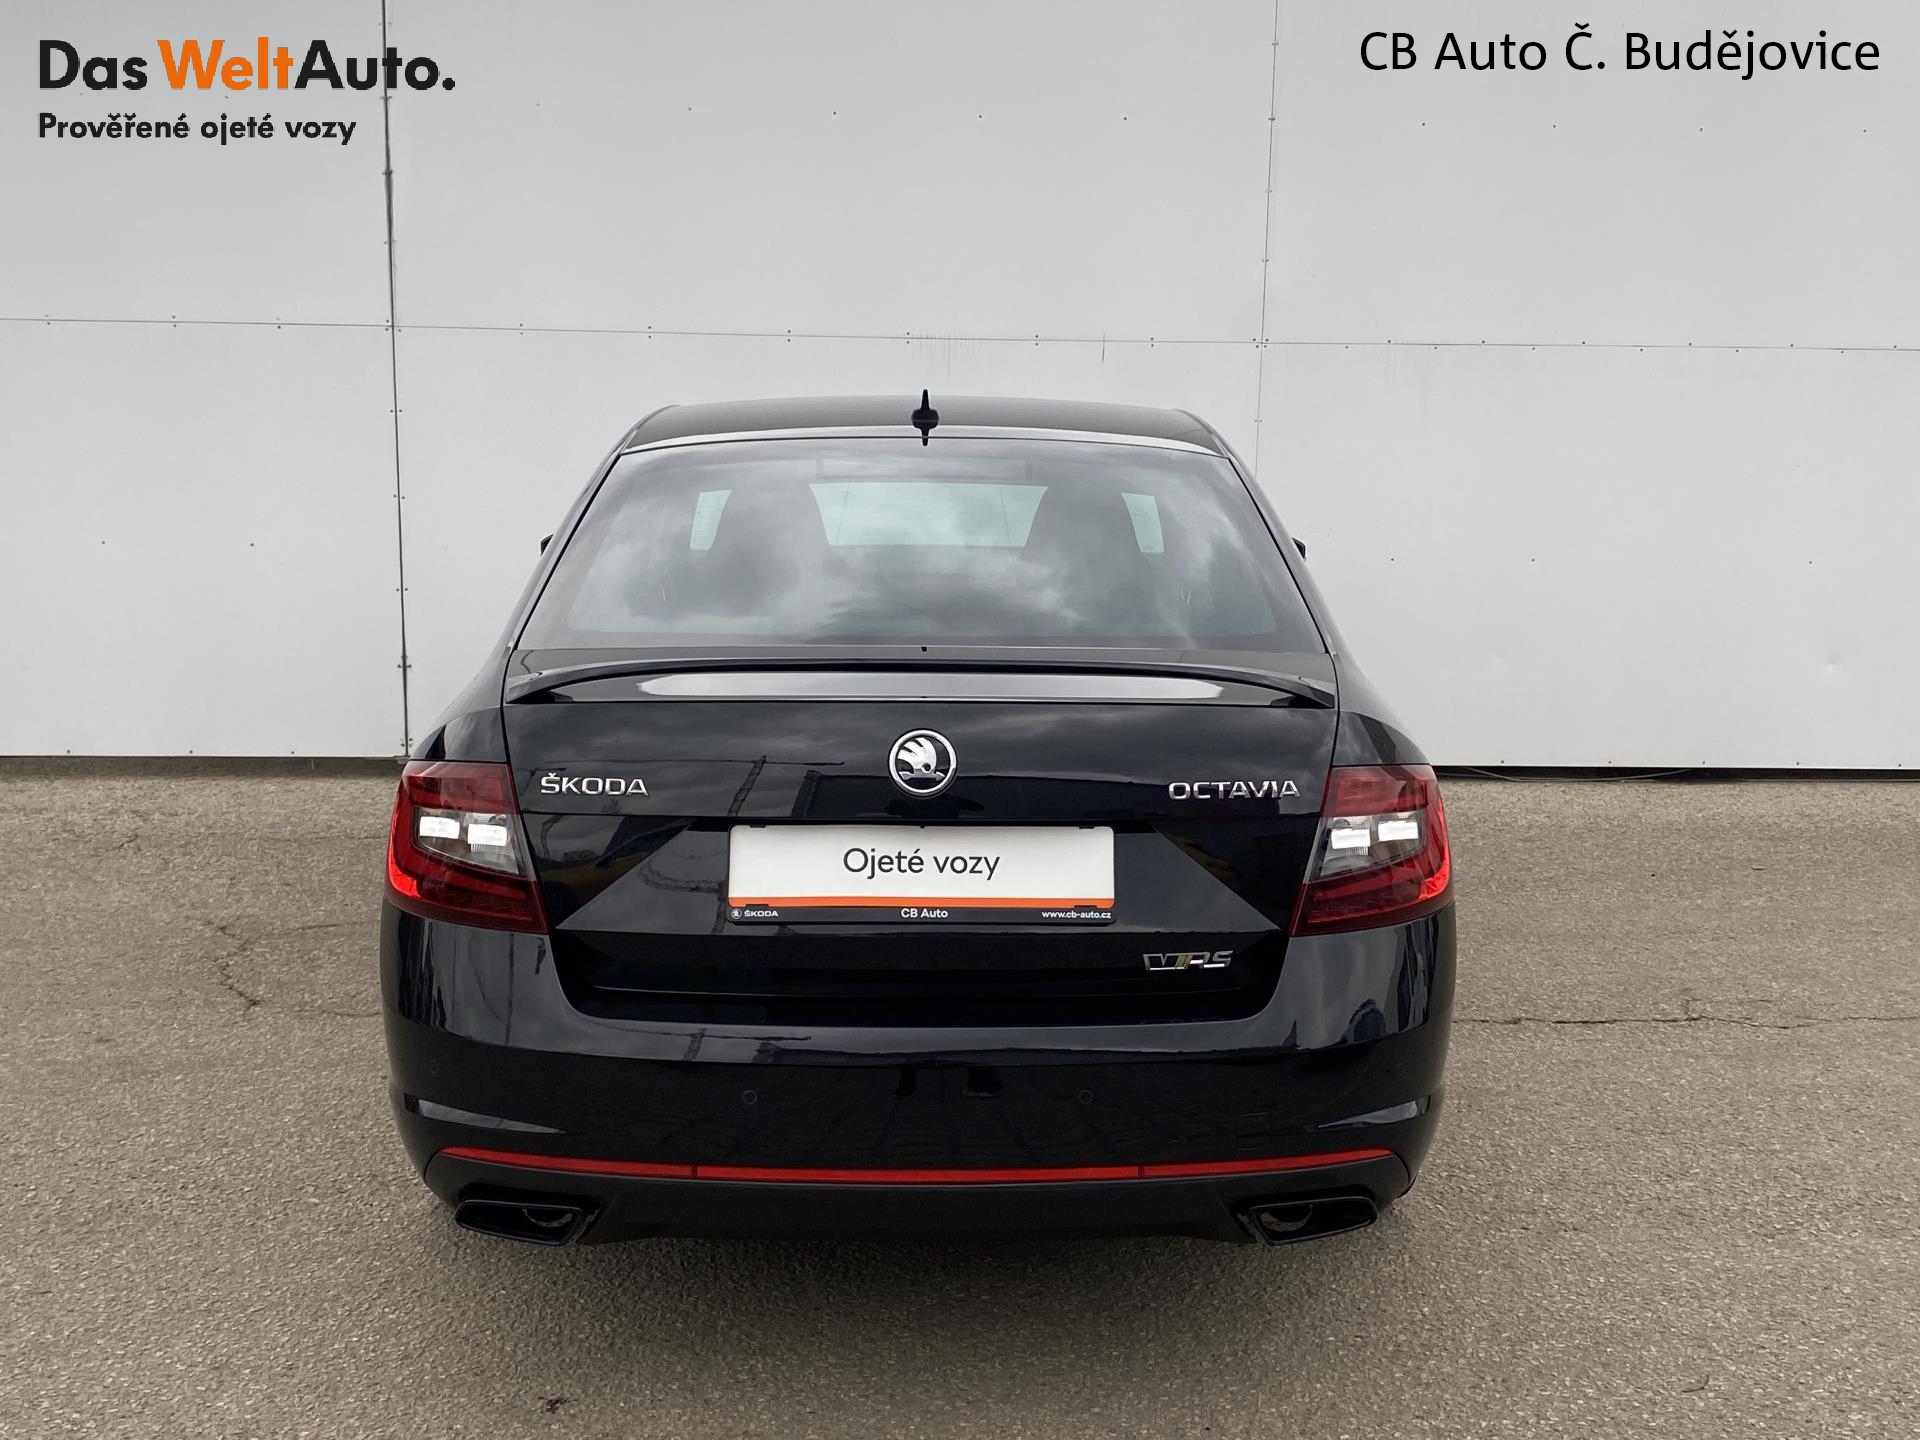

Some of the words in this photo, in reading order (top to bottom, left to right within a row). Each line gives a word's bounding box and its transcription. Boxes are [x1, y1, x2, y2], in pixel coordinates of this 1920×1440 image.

[540, 772, 649, 796] ŠKODA
[1168, 780, 1301, 800] OCTAVIA
[843, 847, 925, 880] Ojeté
[933, 855, 1001, 881] vozy
[900, 907, 919, 919] CB
[920, 907, 949, 919] Auto
[1041, 910, 1112, 920] www.cb-auto.cz
